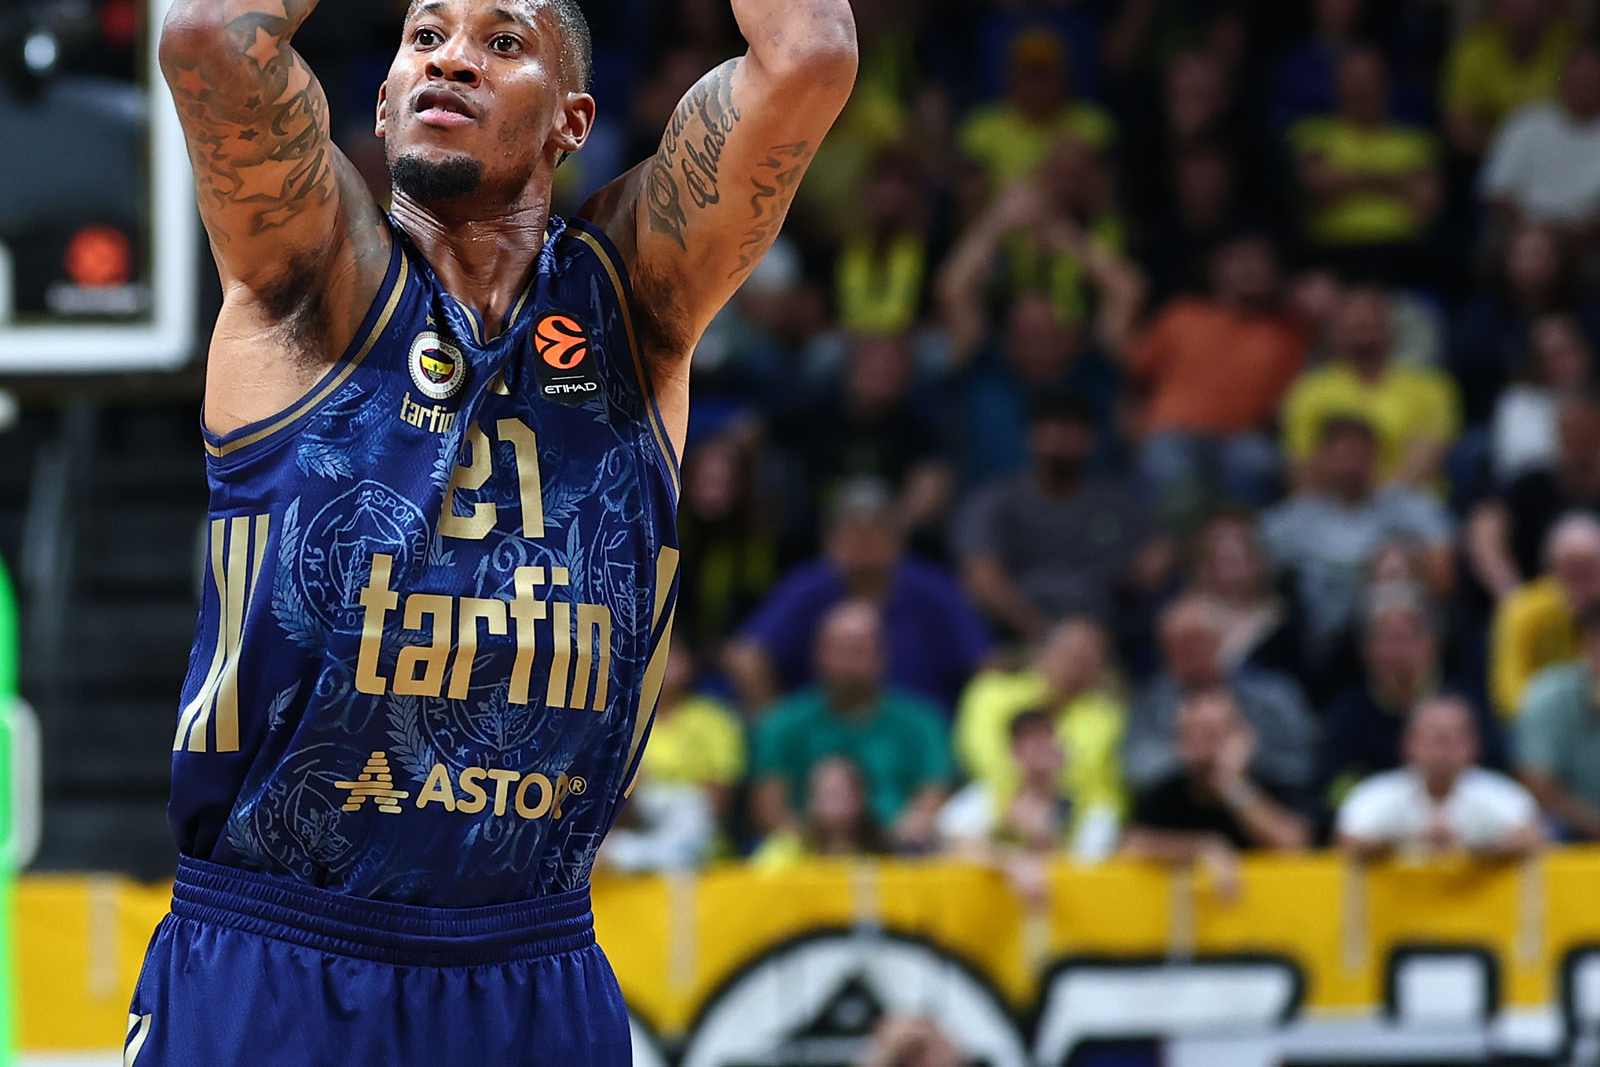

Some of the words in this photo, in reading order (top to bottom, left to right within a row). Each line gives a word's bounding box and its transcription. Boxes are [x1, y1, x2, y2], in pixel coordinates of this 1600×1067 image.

[400, 391, 456, 434] tarfin
[544, 382, 598, 394] ETIHAD
[436, 417, 545, 540] 21
[355, 553, 612, 713] tarfin
